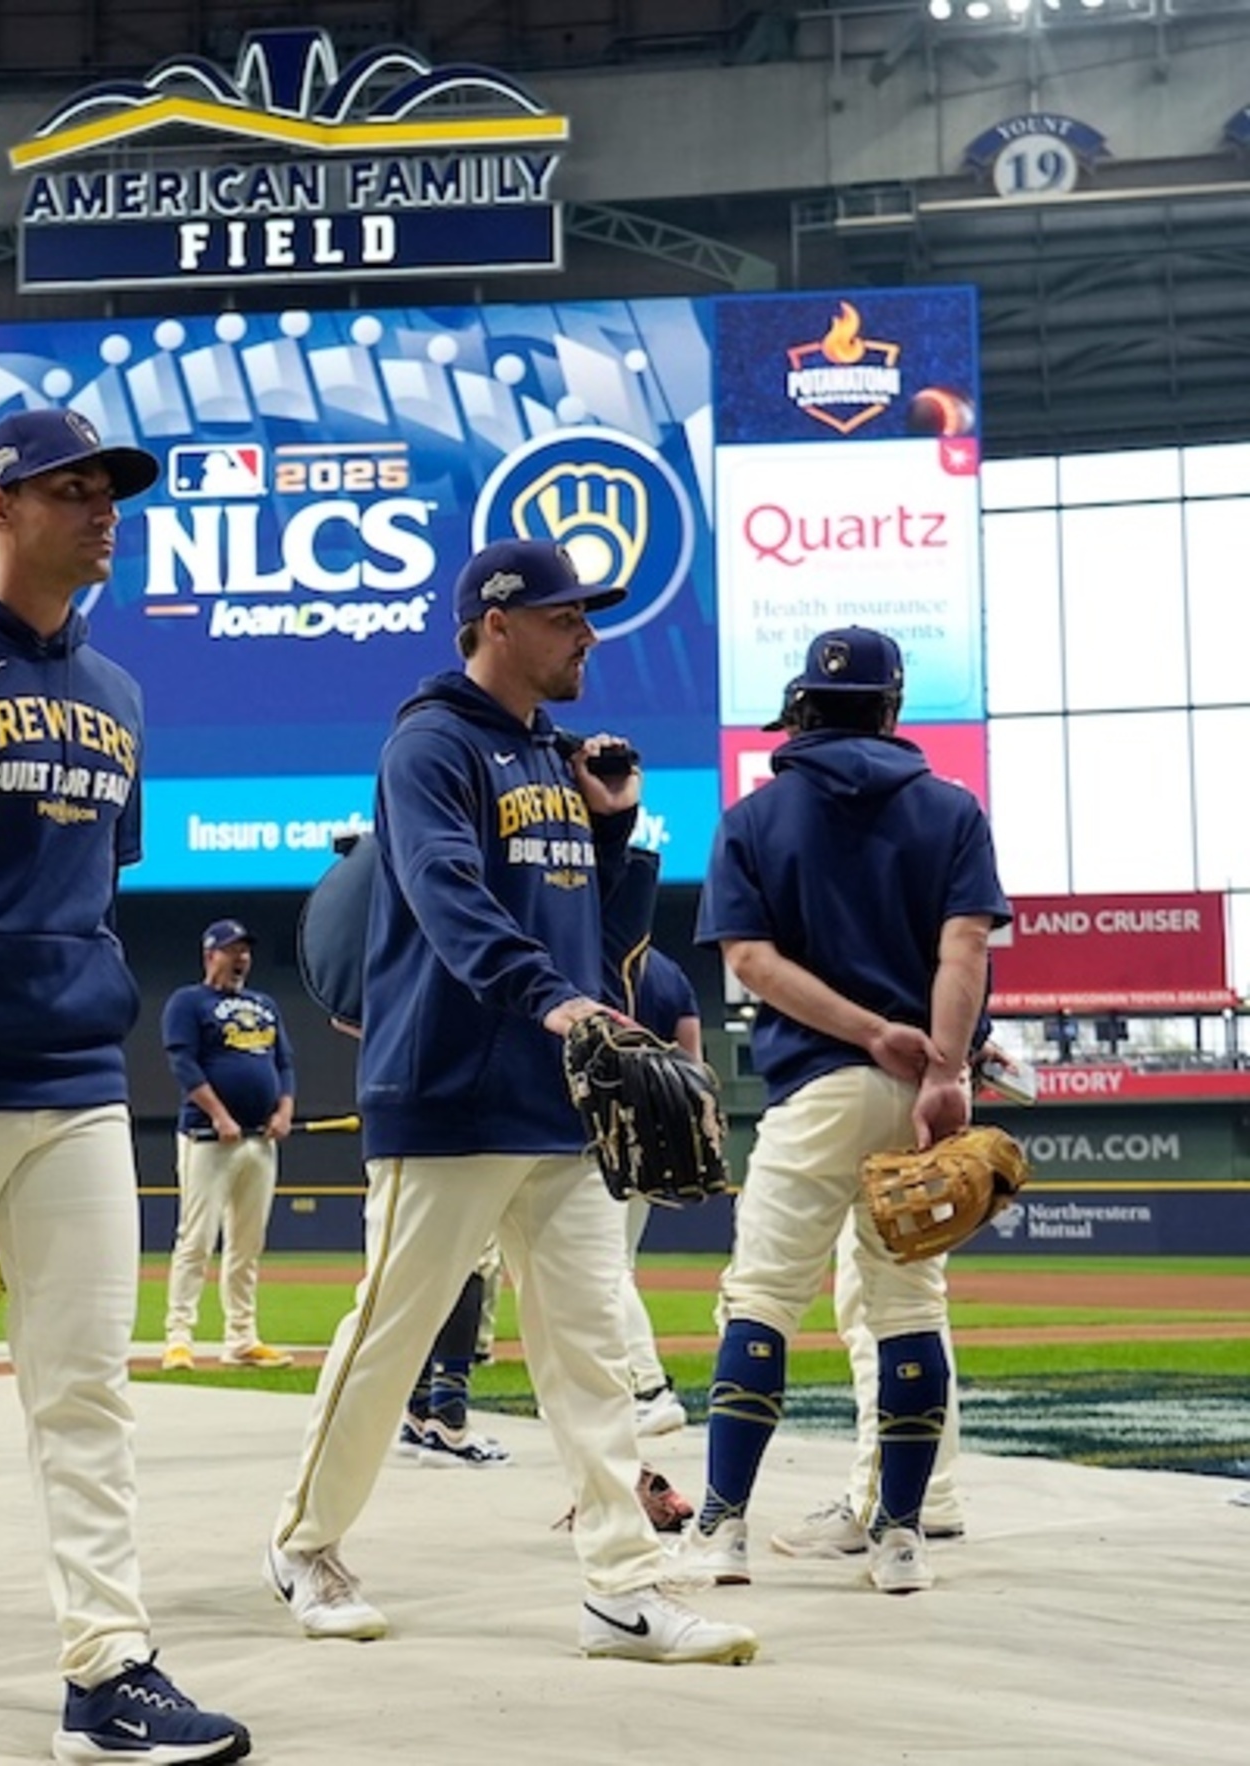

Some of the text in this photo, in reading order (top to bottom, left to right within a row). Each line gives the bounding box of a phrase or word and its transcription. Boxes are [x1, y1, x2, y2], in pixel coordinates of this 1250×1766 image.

[996, 117, 1073, 141] YOUNT
[24, 154, 561, 224] AMERICAN FAMILY
[1005, 150, 1066, 191] 19
[180, 215, 396, 269] FIELD
[275, 459, 409, 493] 2025
[144, 499, 437, 595] NLCS
[742, 503, 948, 567] Quartz
[209, 596, 429, 642] loanDepot
[188, 814, 280, 852] Insure
[1019, 909, 1201, 934] LAND CRUISER
[1027, 1203, 1152, 1222] Northwestern
[1027, 1221, 1092, 1239] Mutual
